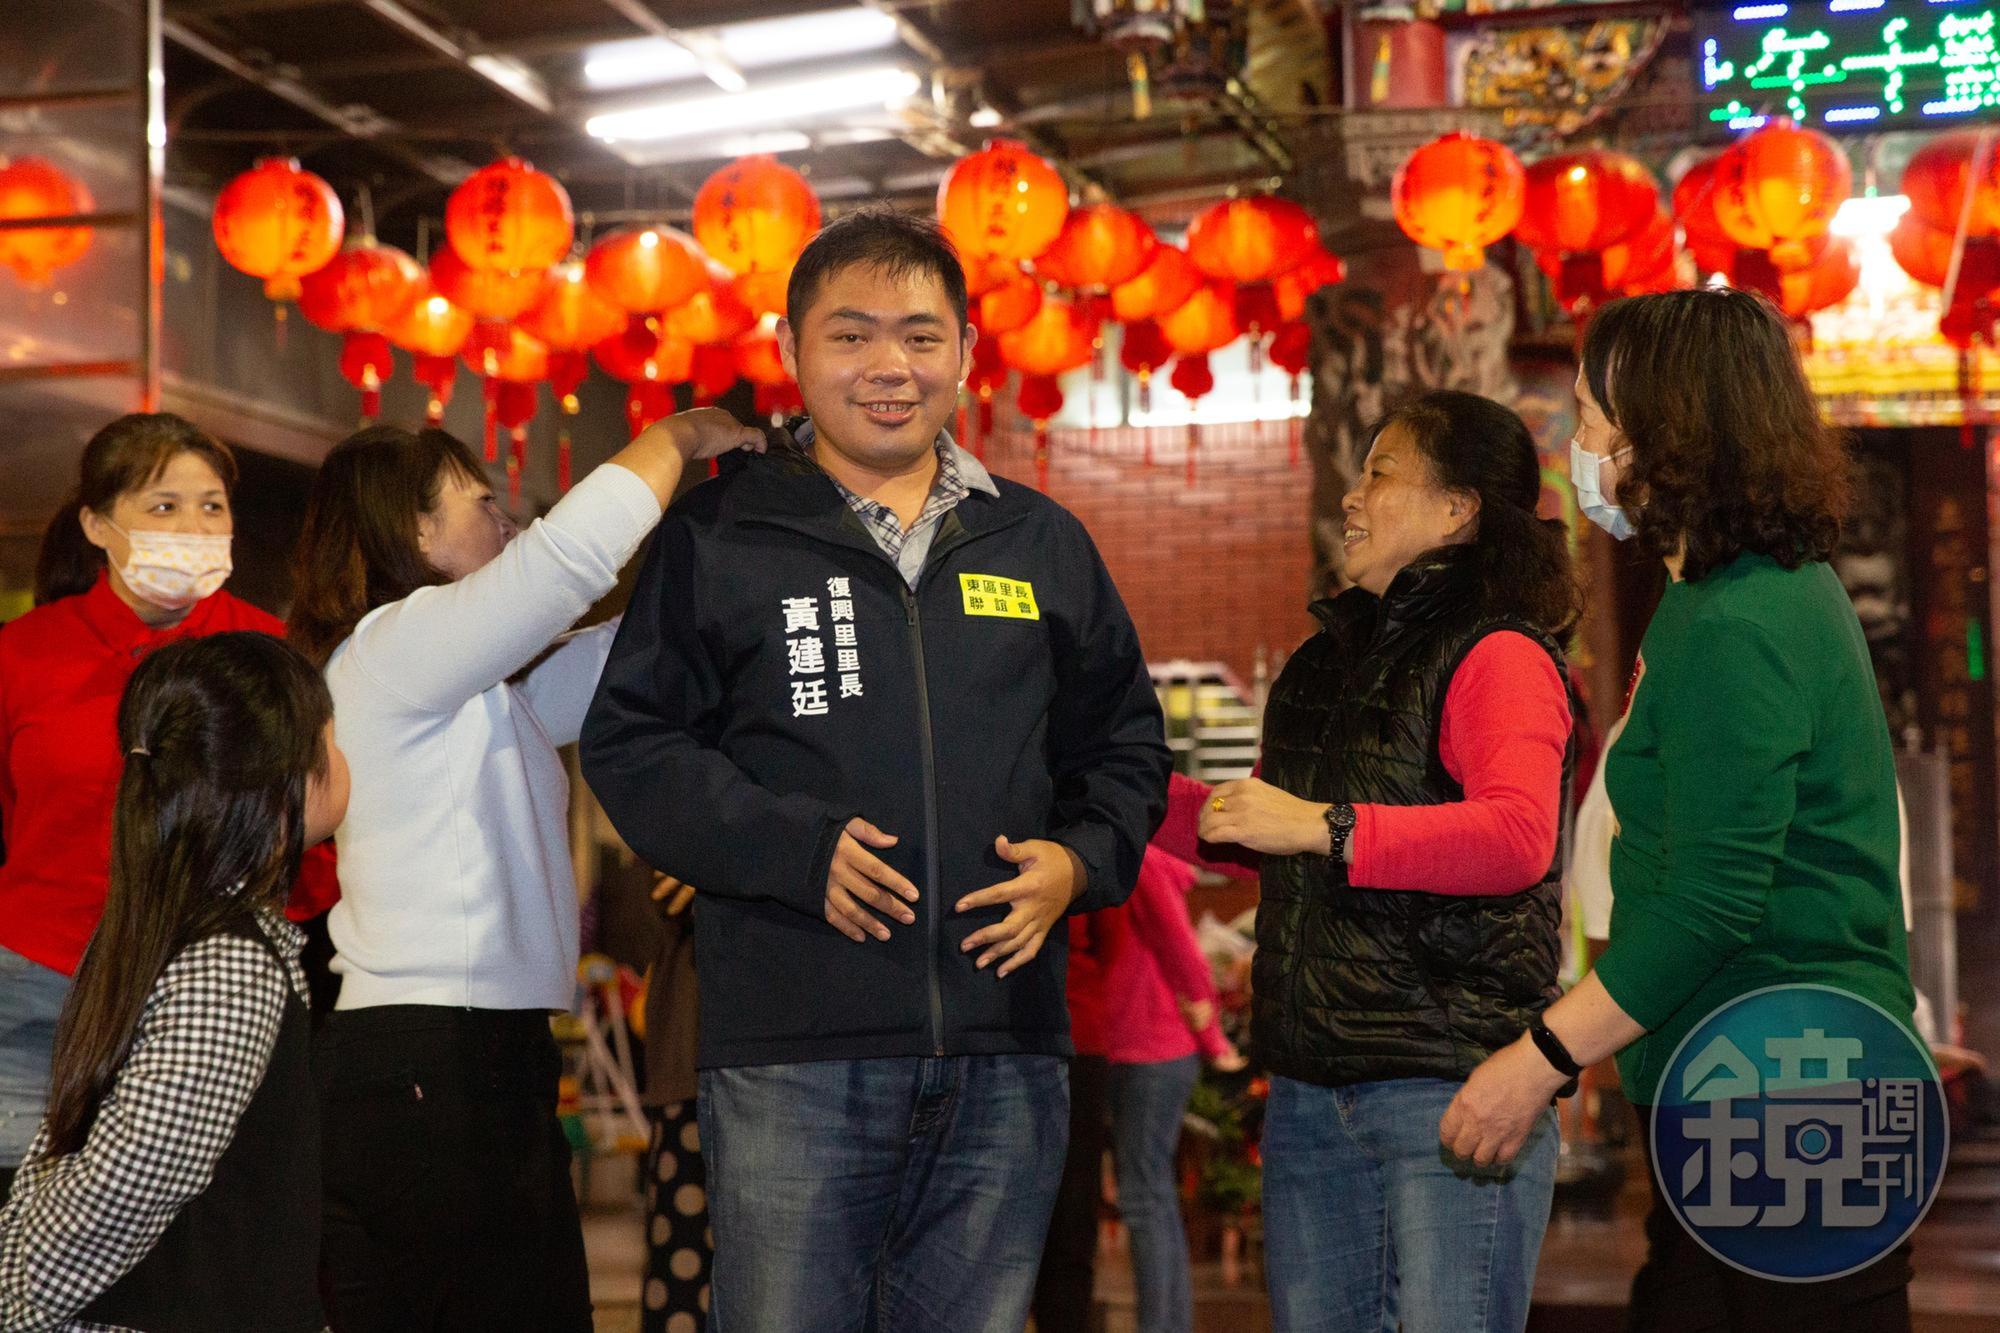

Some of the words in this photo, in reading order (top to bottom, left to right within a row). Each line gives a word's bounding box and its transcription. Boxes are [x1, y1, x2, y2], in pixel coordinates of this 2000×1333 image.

[967, 578, 1028, 600] 東區里長
[968, 595, 1032, 615] 聯誼會
[781, 596, 830, 718] 黃建廷
[826, 576, 864, 699] 復興里里長
